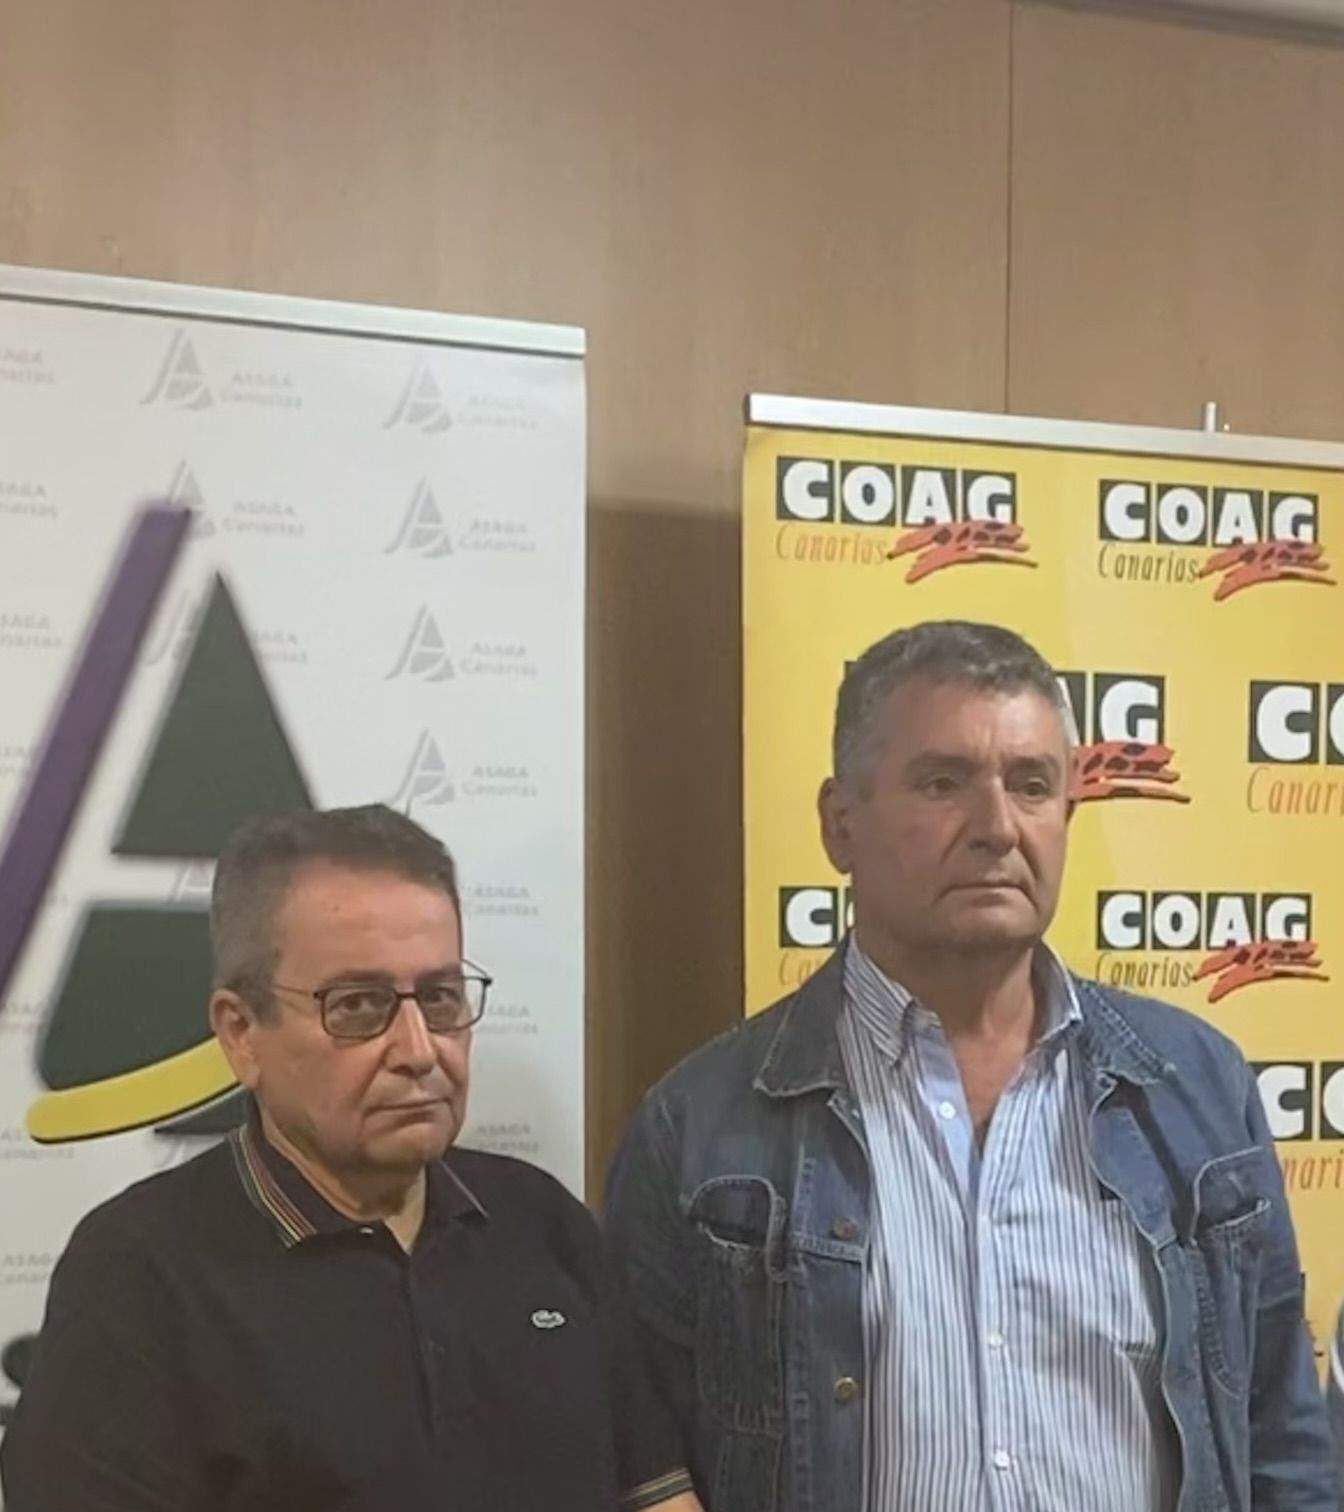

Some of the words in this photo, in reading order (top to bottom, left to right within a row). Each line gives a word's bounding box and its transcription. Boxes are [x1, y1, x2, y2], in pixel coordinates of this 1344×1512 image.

[777, 456, 1017, 527] COAG
[1099, 479, 1318, 546] COAG
[776, 526, 887, 564] Canarias
[1098, 542, 1197, 584] Canarias
[1098, 890, 1311, 951] COAG
[1096, 950, 1194, 987] Canarias
